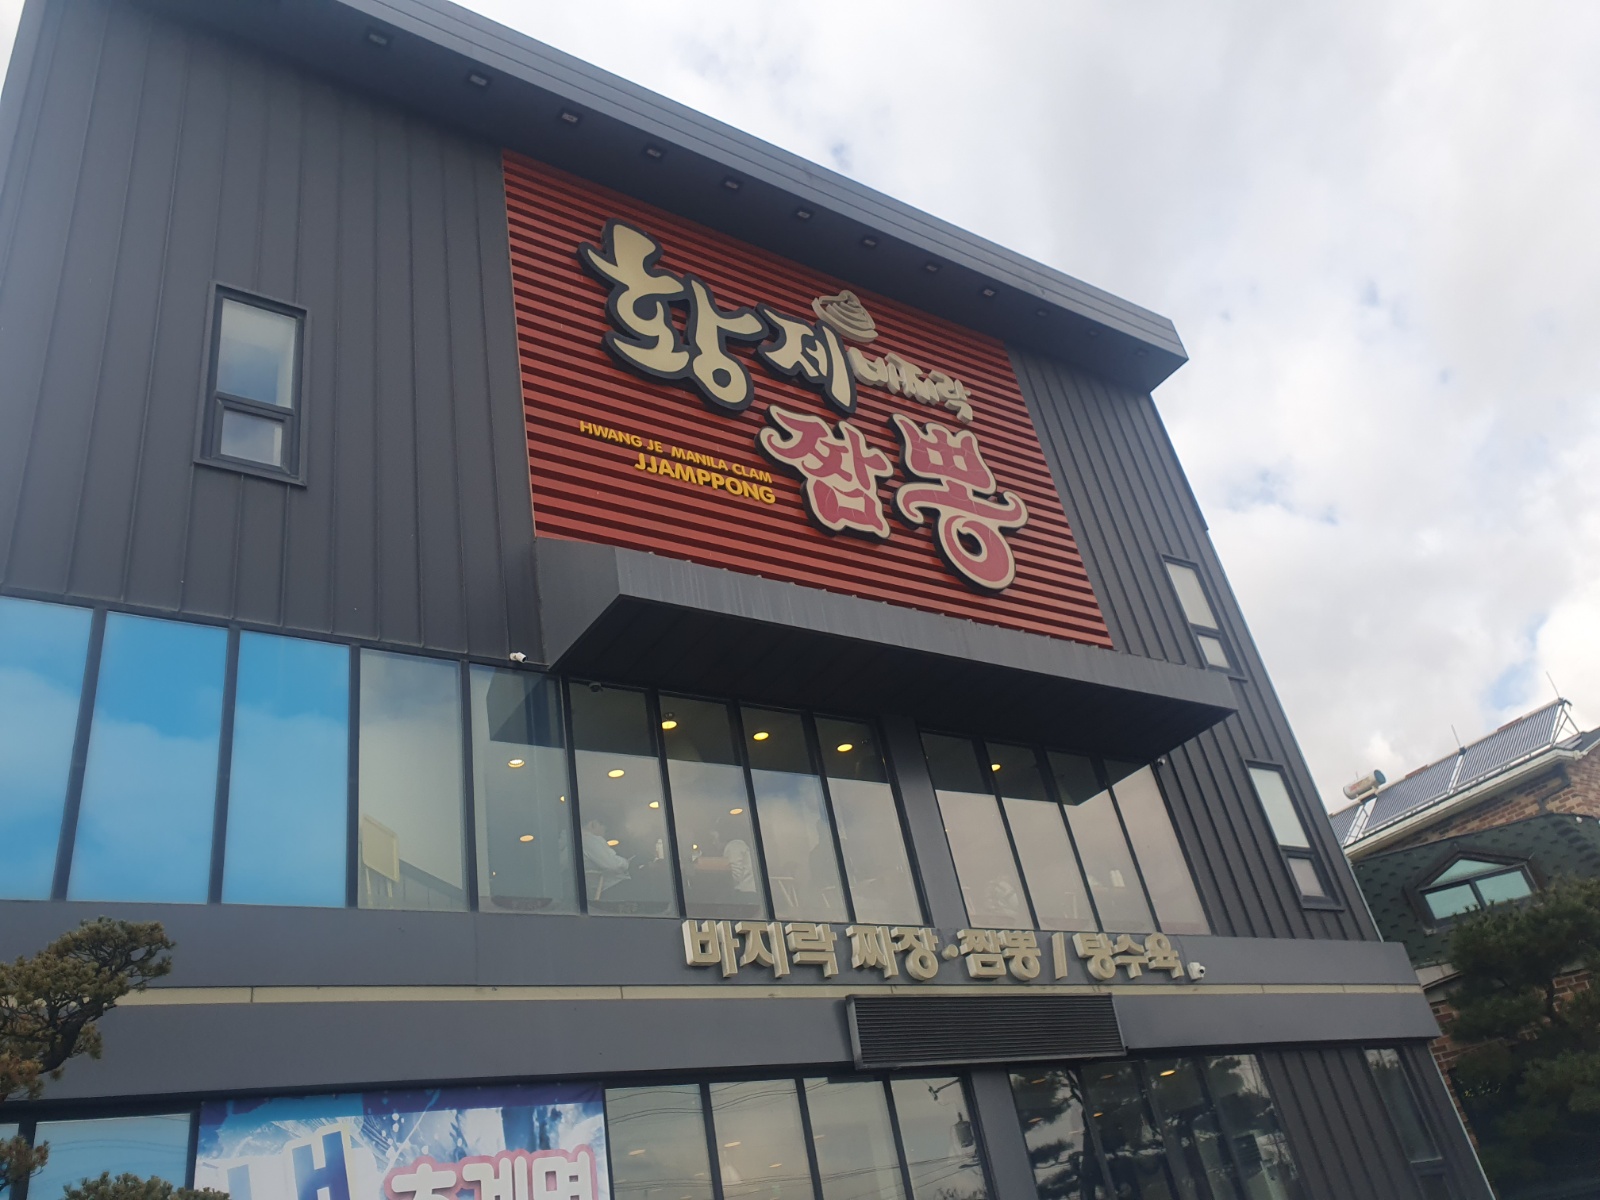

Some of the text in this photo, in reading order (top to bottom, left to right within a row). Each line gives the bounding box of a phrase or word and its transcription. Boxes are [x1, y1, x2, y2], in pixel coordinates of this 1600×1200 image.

[580, 219, 856, 413] 황제
[847, 347, 974, 424] 바지락
[579, 420, 773, 484] HWANG JE MANILA CLAM
[634, 452, 776, 504] JJAMPPONG
[757, 404, 1030, 593] 짬뽕
[682, 919, 839, 978] 바지락
[1072, 932, 1185, 980] 탕수육
